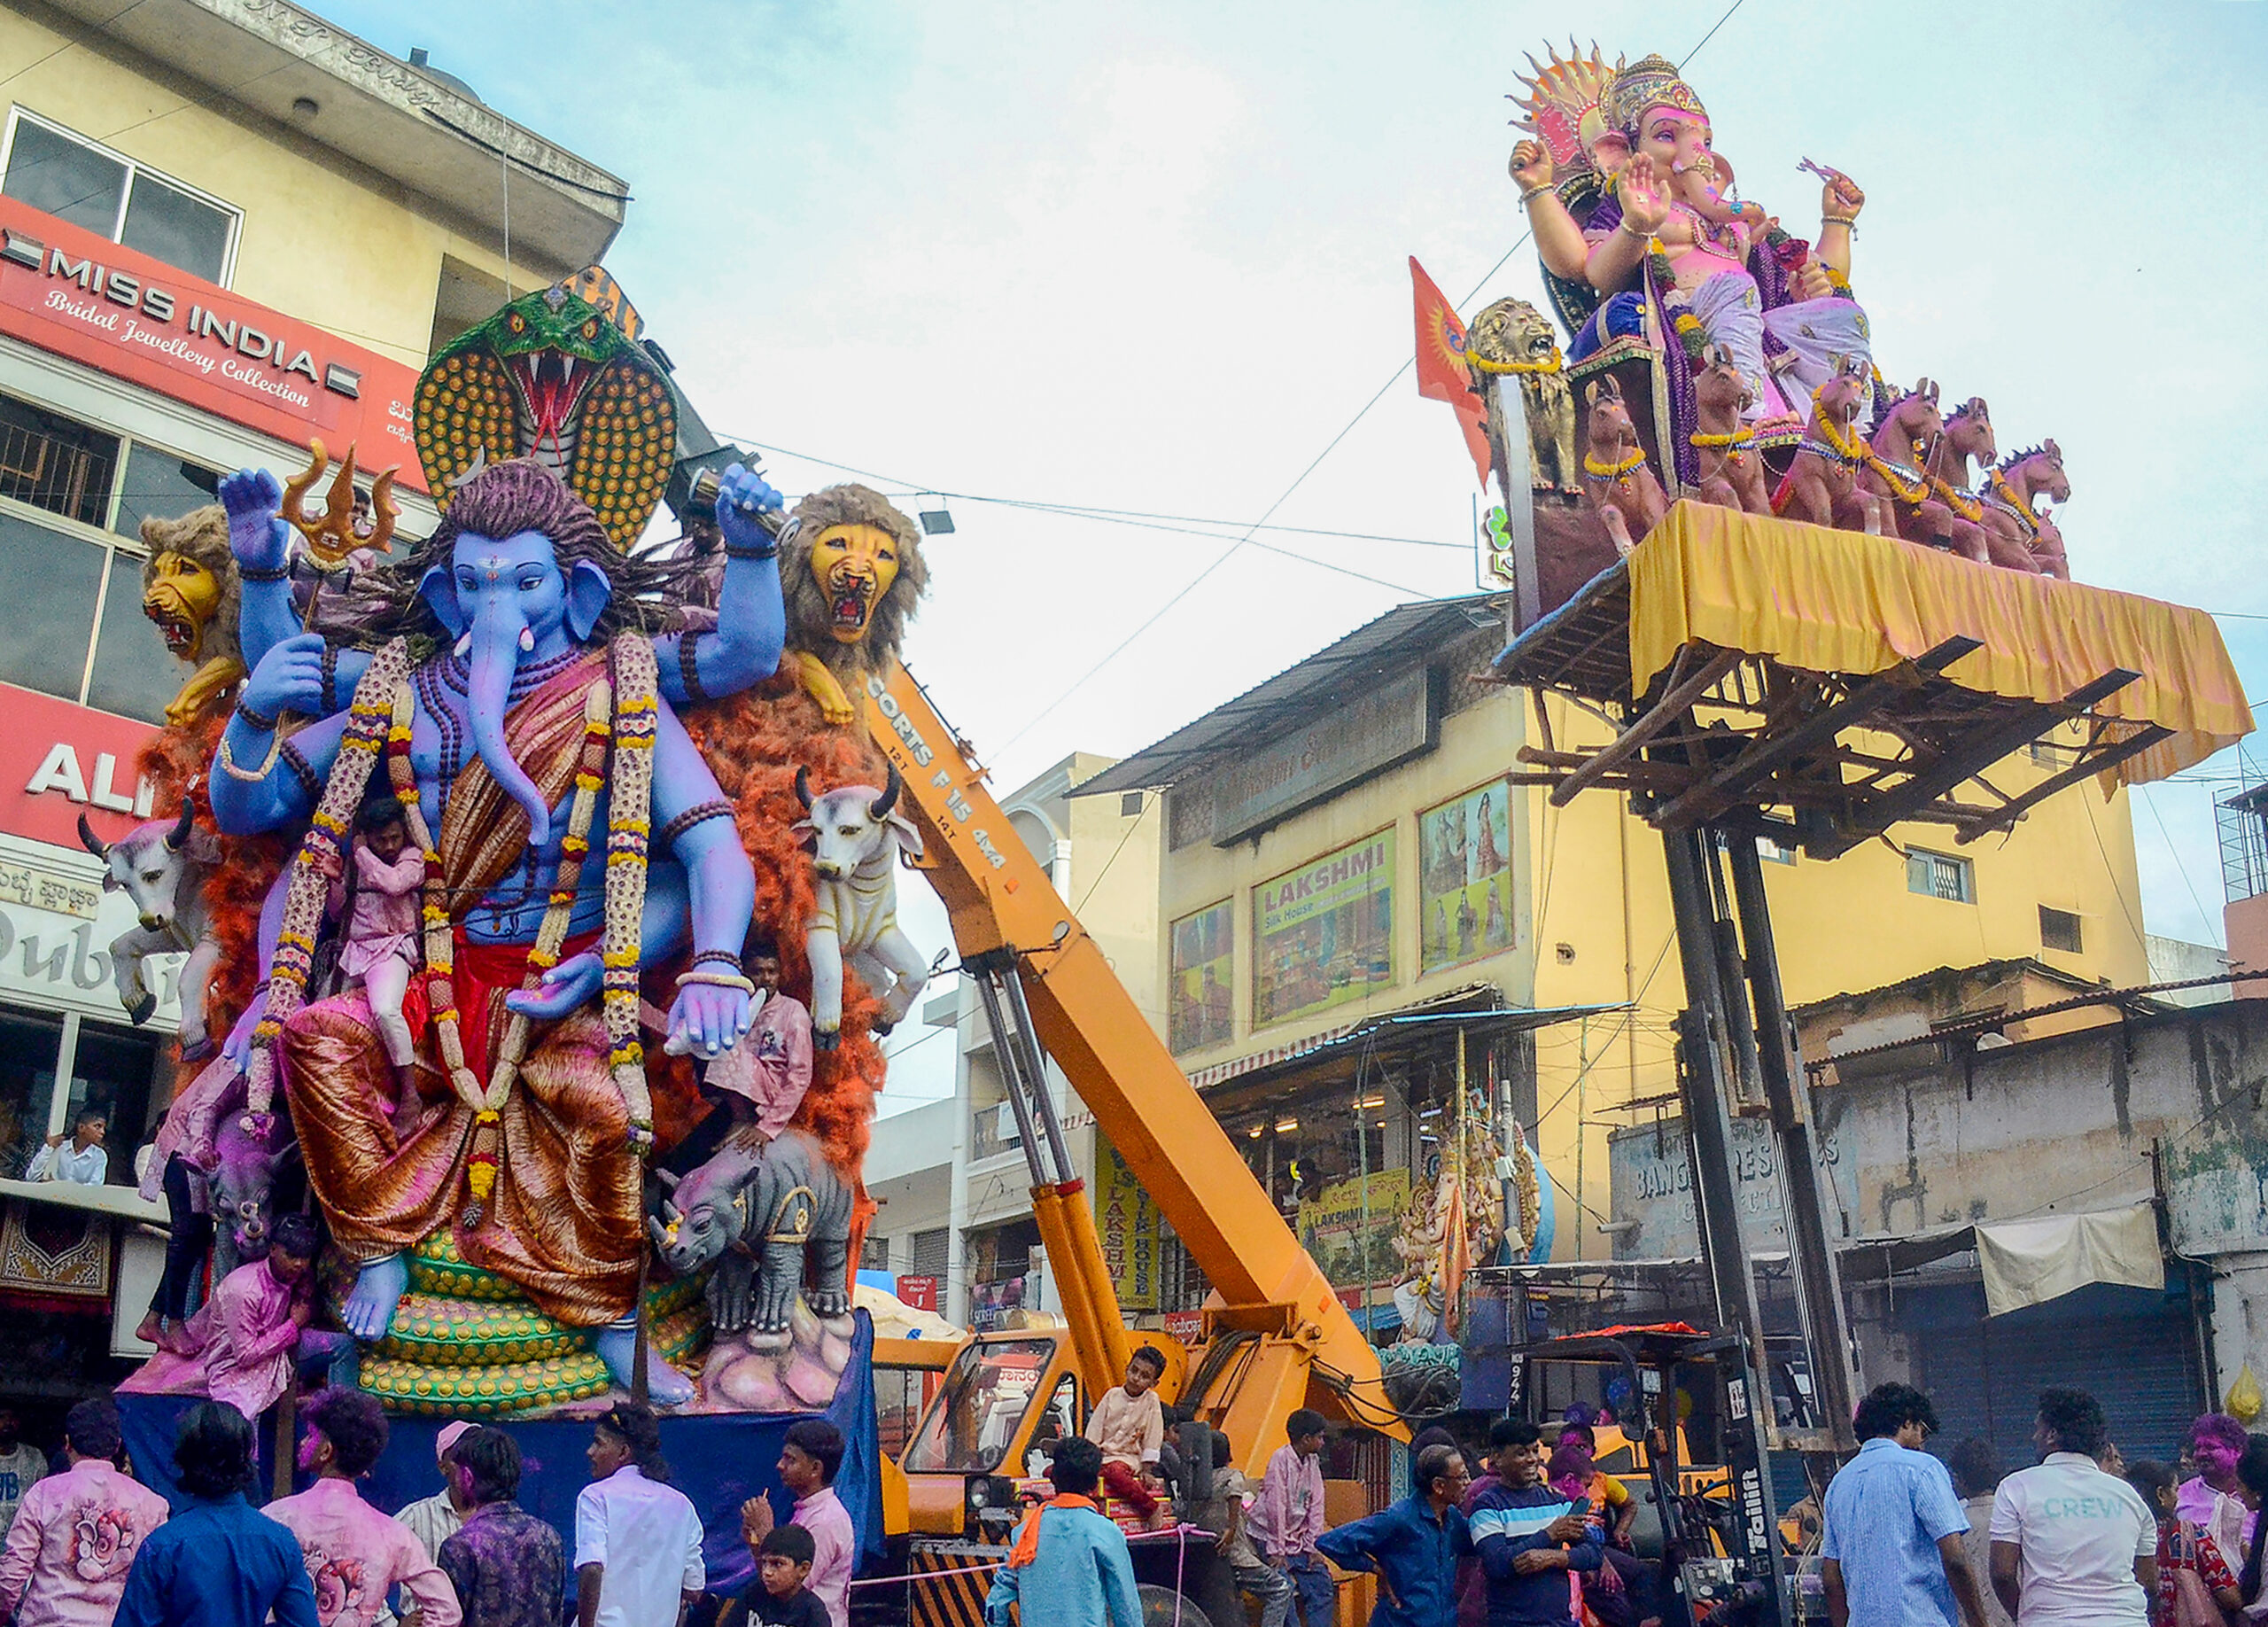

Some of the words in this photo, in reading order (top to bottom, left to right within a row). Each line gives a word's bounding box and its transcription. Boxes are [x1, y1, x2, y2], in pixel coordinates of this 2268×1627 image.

[44, 290, 117, 332] Bridal
[120, 319, 215, 375] Jewellery
[221, 359, 310, 409] Collection
[48, 248, 175, 322] MISS
[187, 305, 319, 383] INDIA
[1264, 842, 1385, 914] LAKSHMI
[1315, 1206, 1363, 1228] LAKSHMI
[1742, 1467, 1768, 1554] Tailift
[2043, 1497, 2124, 1519] CREW
